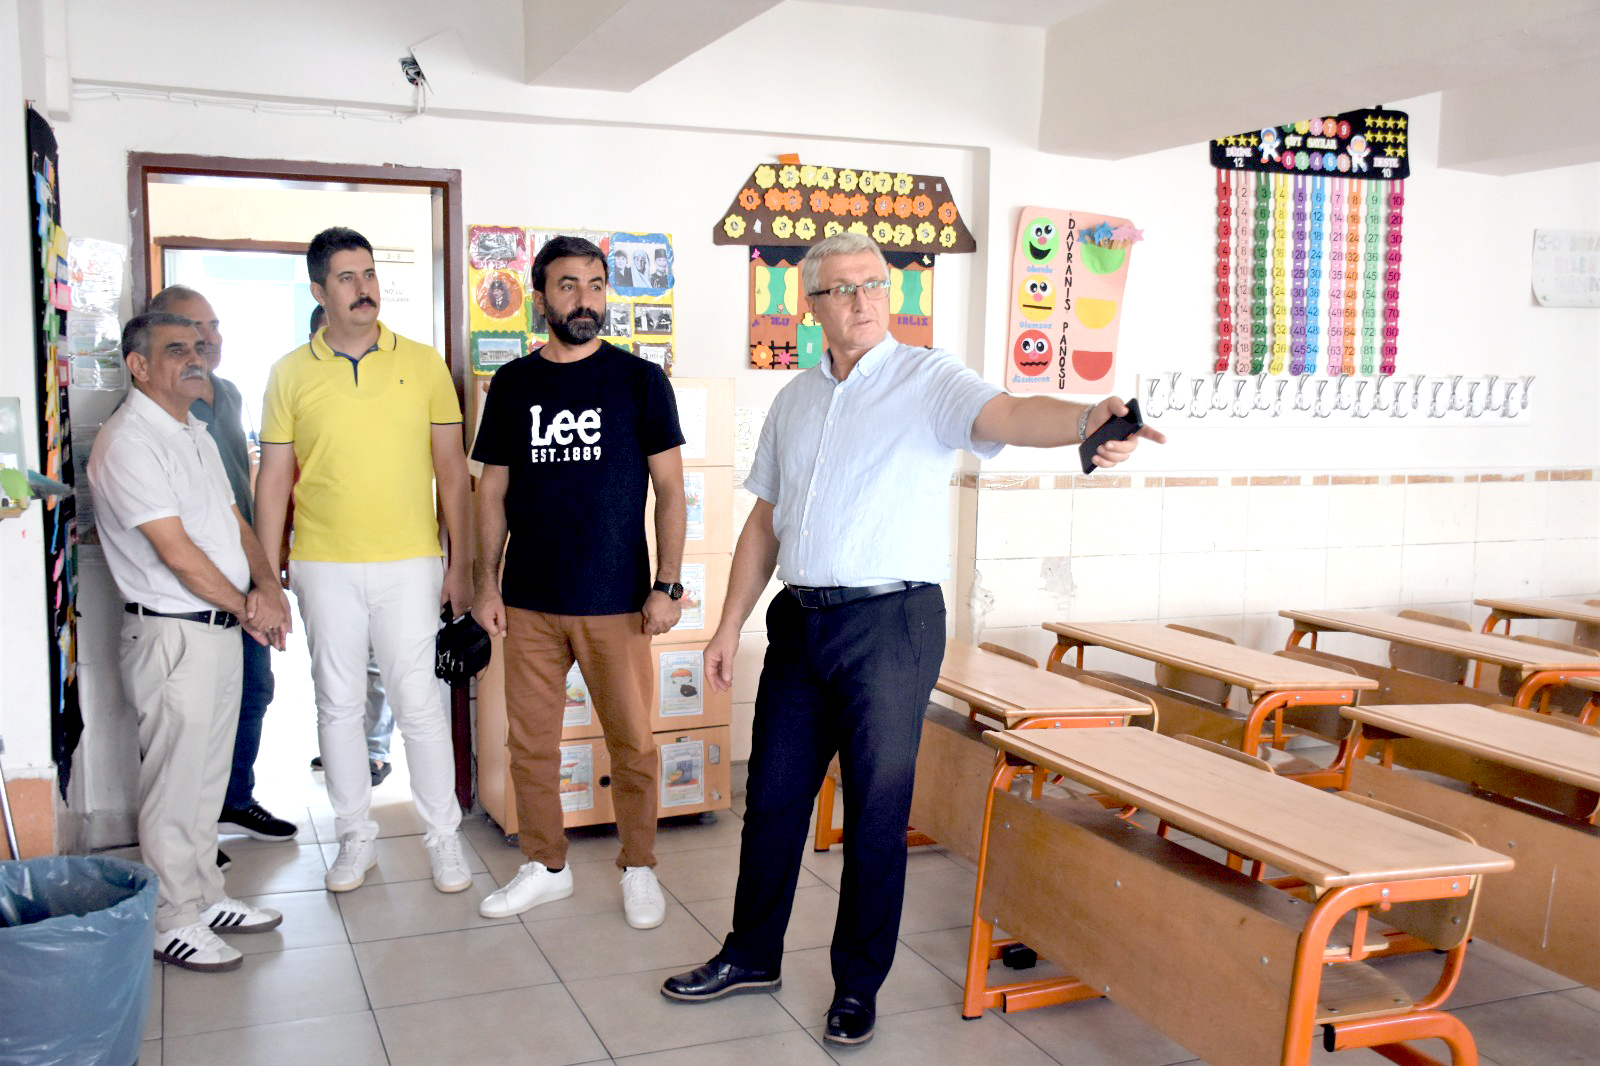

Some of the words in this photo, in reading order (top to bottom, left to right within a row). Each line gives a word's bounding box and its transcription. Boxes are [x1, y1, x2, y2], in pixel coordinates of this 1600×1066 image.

[1314, 122, 1318, 131] 5
[1328, 124, 1332, 133] 7
[1342, 125, 1346, 135] 9
[1233, 158, 1244, 168] 12
[1286, 156, 1291, 165] 0
[1301, 156, 1305, 165] 2
[1314, 157, 1319, 166] 4
[1328, 157, 1332, 166] 6
[1342, 159, 1346, 168] 8
[822, 172, 829, 181] 4
[846, 175, 851, 183] 5
[865, 177, 870, 186] 6
[880, 179, 885, 187] 7
[1382, 168, 1391, 178] 10
[1223, 186, 1227, 196] 1
[1241, 187, 1247, 198] 2
[1261, 188, 1267, 196] 3
[1279, 190, 1285, 198] 4
[1298, 192, 1303, 202] 5
[1316, 193, 1322, 202] 6
[1336, 194, 1341, 204] 7
[1352, 196, 1358, 205] 8
[1371, 196, 1378, 205] 9
[1392, 196, 1403, 206] 10
[746, 195, 754, 204] 0
[790, 196, 796, 204] 2
[946, 209, 952, 217] 9
[1223, 205, 1229, 216] 2
[1241, 208, 1247, 216] 4
[1260, 209, 1266, 218] 6
[1279, 210, 1284, 219] 8
[1296, 212, 1305, 221] 10
[1314, 211, 1322, 222] 12
[1333, 213, 1342, 222] 14
[1350, 215, 1359, 224] 16
[1370, 215, 1379, 224] 18
[1391, 215, 1402, 225] 20
[731, 221, 738, 231] 0
[803, 223, 810, 231] 4
[879, 229, 885, 237] 6
[899, 233, 905, 241] 7
[946, 234, 950, 242] 9
[1223, 225, 1229, 236] 3
[1241, 227, 1247, 235] 6
[1260, 229, 1265, 239] 9
[1277, 229, 1284, 239] 12
[1296, 231, 1305, 240] 15
[1314, 231, 1322, 241] 18
[1333, 232, 1342, 241] 21
[1349, 233, 1359, 242] 24
[1368, 234, 1379, 243] 27
[1391, 235, 1402, 244] 30
[1223, 247, 1228, 256] 4
[1241, 246, 1247, 256] 8
[1257, 248, 1265, 258] 12
[1295, 250, 1305, 259] 20
[1310, 250, 1321, 259] 24
[1332, 252, 1343, 261] 28
[1347, 252, 1358, 262] 32
[1367, 252, 1377, 262] 36
[1388, 253, 1401, 262] 40
[1223, 265, 1227, 275] 5
[1239, 266, 1248, 276] 10
[1257, 267, 1265, 277] 15
[1275, 267, 1285, 277] 20
[1293, 269, 1305, 279] 25
[1310, 269, 1320, 279] 30
[1332, 271, 1342, 280] 35
[1346, 272, 1357, 280] 40
[1365, 272, 1377, 280] 45
[1388, 272, 1400, 281] 50
[1223, 284, 1228, 294] 6
[1239, 285, 1247, 295] 12
[1257, 287, 1265, 296] 18
[1275, 287, 1284, 295] 24
[1293, 288, 1304, 297] 30
[1309, 288, 1319, 297] 36
[1330, 290, 1341, 299] 42
[1346, 291, 1356, 299] 48
[1365, 290, 1376, 299] 54
[1387, 290, 1399, 300] 60
[1223, 304, 1228, 314] 7
[1240, 305, 1248, 313] 14
[1256, 307, 1265, 316] 21
[1276, 305, 1286, 315] 28
[1293, 307, 1304, 317] 35
[1307, 307, 1318, 317] 42
[1331, 309, 1341, 318] 49
[1345, 309, 1356, 318] 56
[1365, 309, 1375, 318] 63
[1388, 309, 1399, 318] 70
[1223, 324, 1230, 333] 8
[1239, 324, 1248, 333] 16
[1254, 325, 1267, 334] 24
[1276, 325, 1286, 334] 32
[1293, 327, 1306, 336] 40
[1307, 326, 1319, 335] 48
[1331, 327, 1341, 336] 56
[1344, 327, 1355, 336] 64
[1364, 327, 1374, 337] 72
[1386, 328, 1398, 337] 80
[1059, 322, 1068, 390] PANOSU
[1223, 343, 1229, 353] 9
[1240, 344, 1249, 353] 18
[1254, 345, 1265, 354] 27
[1276, 344, 1286, 353] 36
[1294, 345, 1306, 354] 45
[1306, 344, 1318, 353] 54
[1330, 346, 1341, 355] 63
[1344, 346, 1354, 356] 72
[1363, 346, 1373, 355] 81
[1385, 346, 1397, 355] 90
[1239, 363, 1249, 373] 20
[1271, 363, 1283, 371] 40
[1292, 364, 1303, 374] 50
[1304, 364, 1315, 373] 60
[1330, 365, 1339, 375] 70
[1344, 365, 1354, 375] 80
[1362, 365, 1373, 374] 90
[530, 405, 601, 446] Lee
[532, 446, 601, 463] EST.1889
